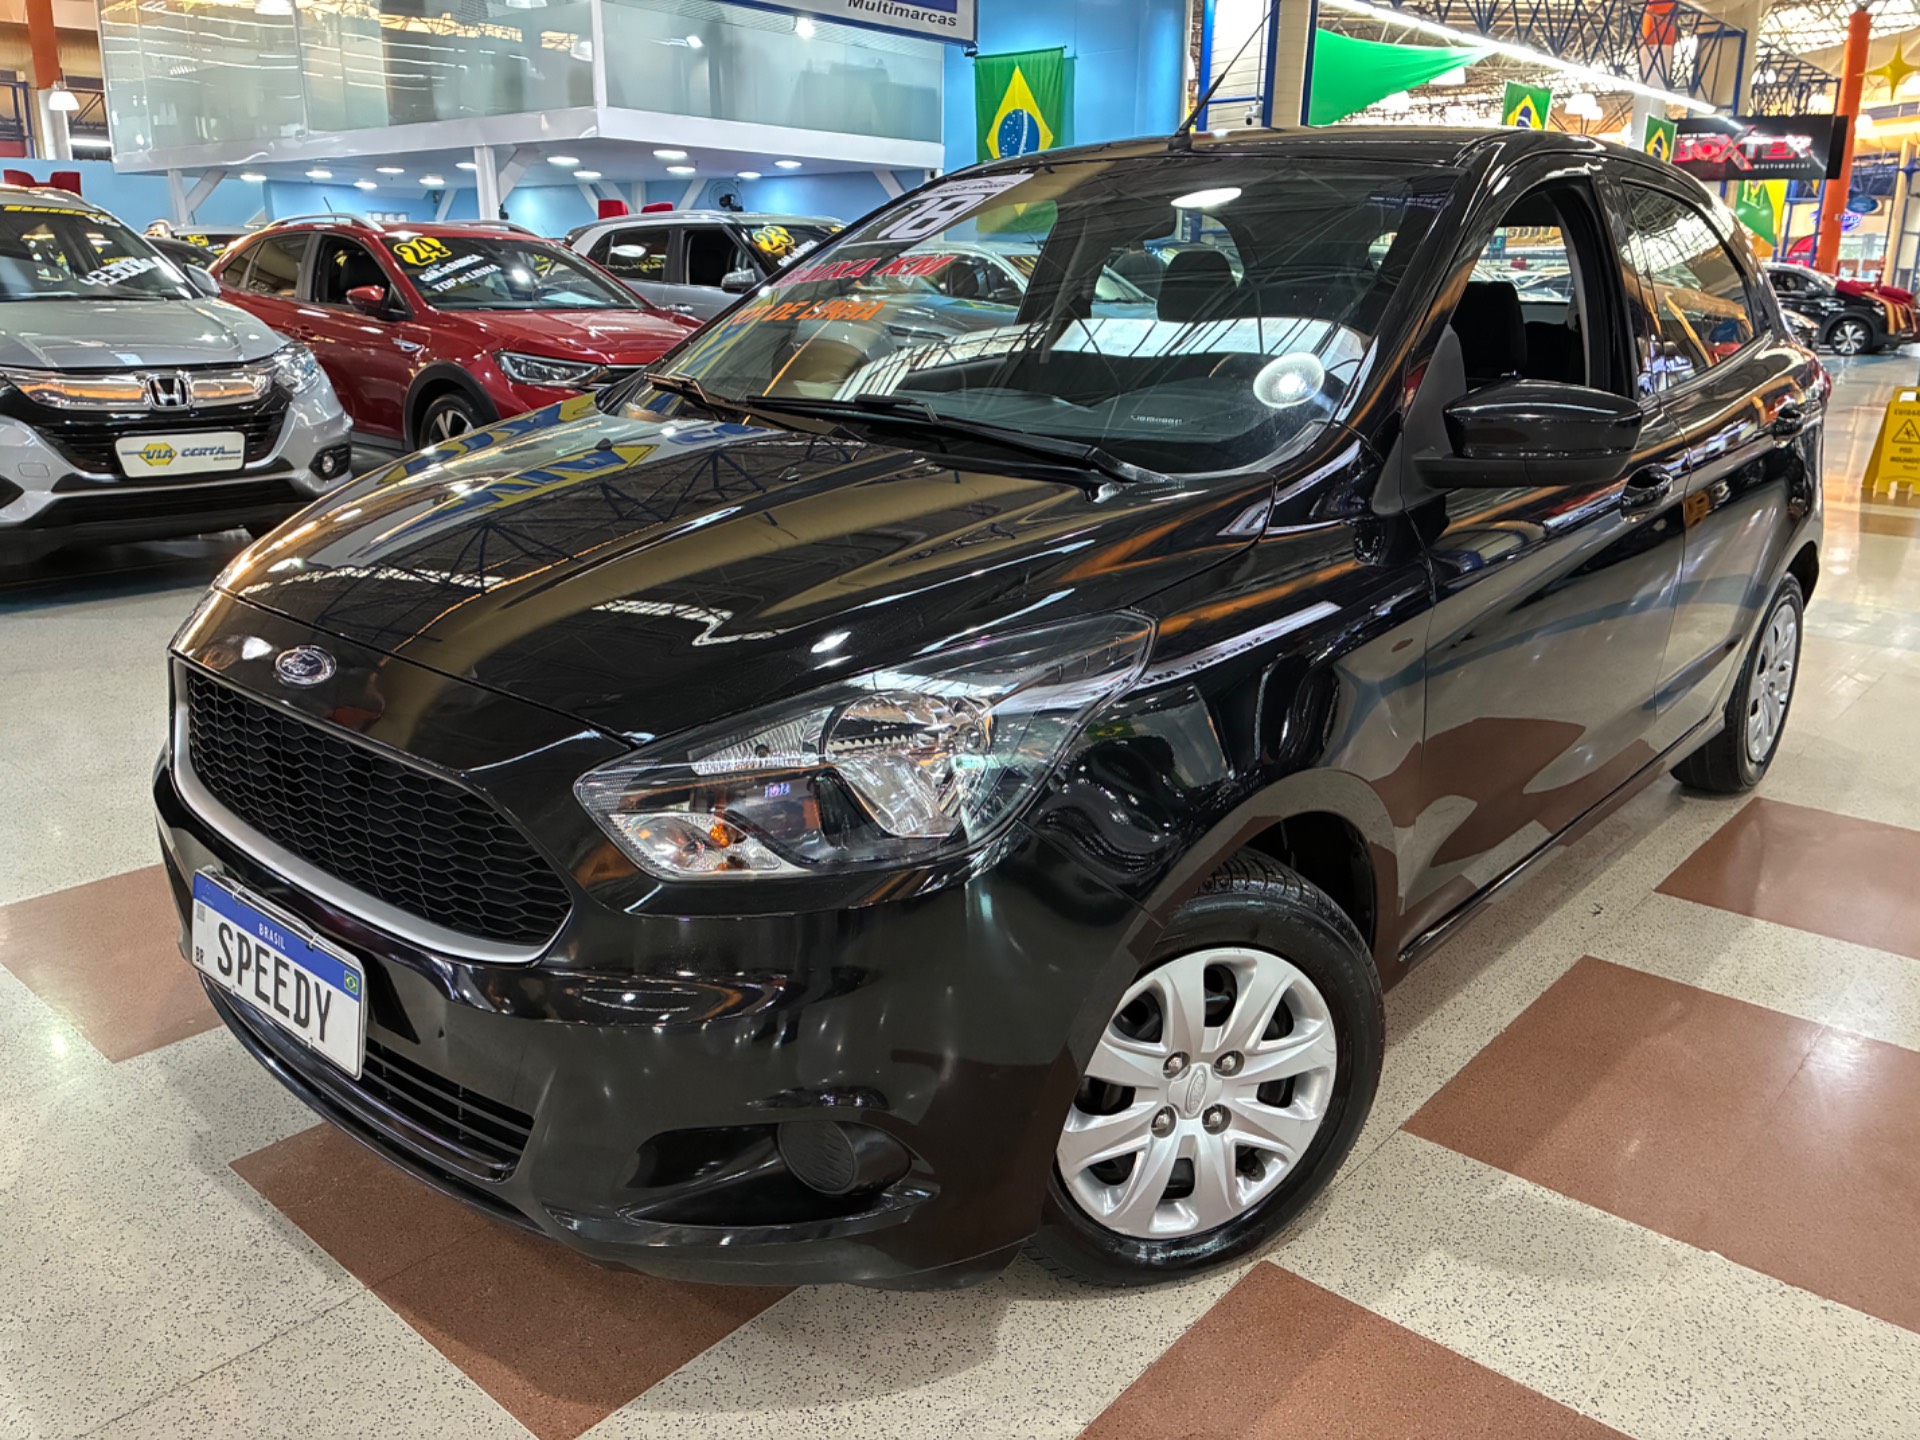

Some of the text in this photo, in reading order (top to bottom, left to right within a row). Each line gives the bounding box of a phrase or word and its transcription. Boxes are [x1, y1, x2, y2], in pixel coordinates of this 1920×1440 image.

[847, 0, 957, 27] Multimarcas
[394, 238, 452, 265] 24
[753, 226, 795, 254] 23
[873, 255, 957, 277] KM
[761, 301, 810, 321] DE
[796, 300, 887, 321] LINHA
[144, 446, 226, 459] VIA CERTA
[258, 922, 286, 950] BRASIL
[195, 945, 205, 966] BR
[217, 922, 332, 1043] SPEEDY
